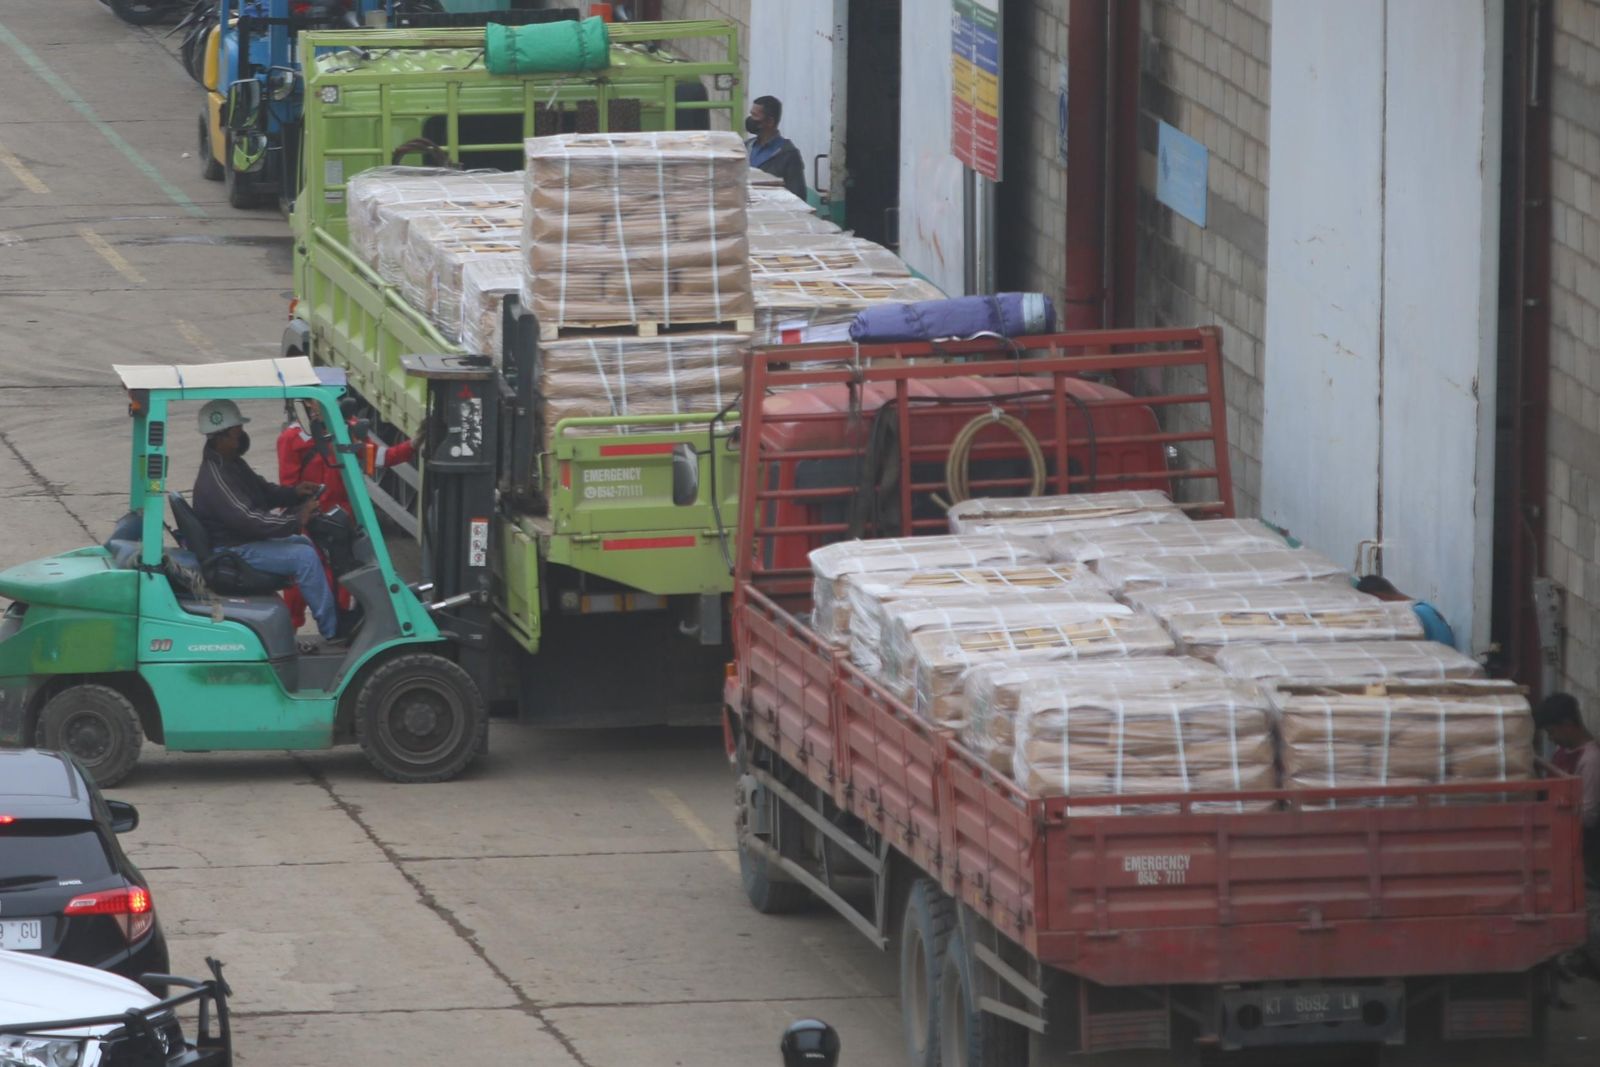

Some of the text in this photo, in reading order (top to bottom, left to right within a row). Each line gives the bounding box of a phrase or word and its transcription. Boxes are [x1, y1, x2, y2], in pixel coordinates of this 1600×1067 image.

[584, 467, 641, 482] EMERGENCY
[1124, 855, 1191, 872] EMERGENCY
[20, 922, 38, 939] GU
